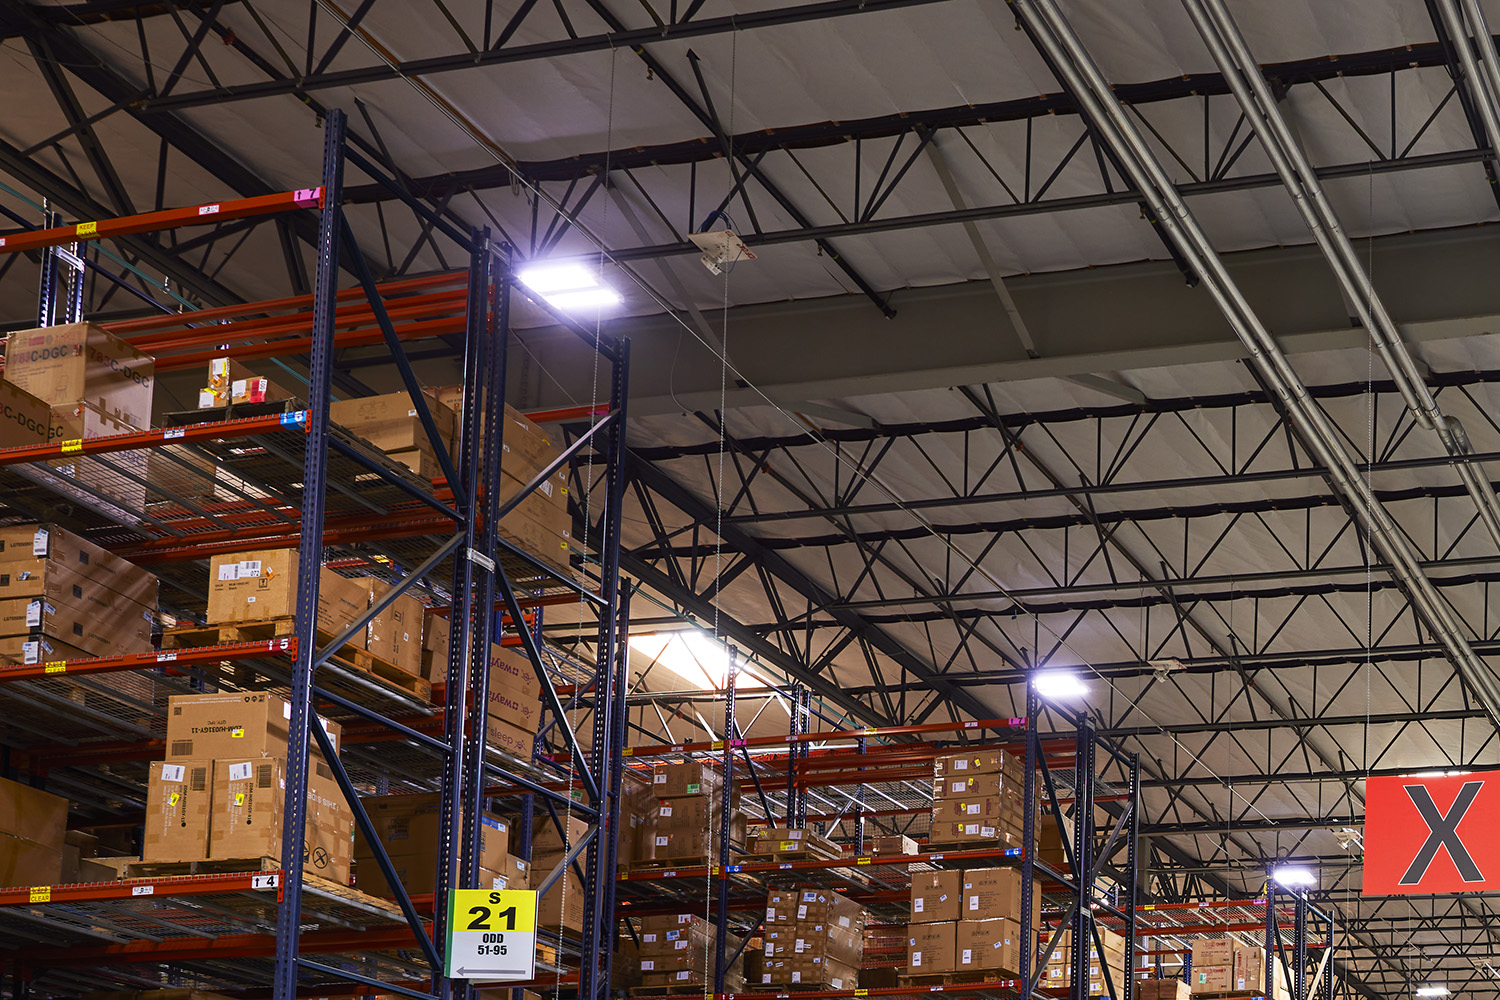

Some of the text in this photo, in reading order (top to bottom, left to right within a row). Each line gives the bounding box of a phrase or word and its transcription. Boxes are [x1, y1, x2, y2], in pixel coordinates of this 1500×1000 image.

[308, 188, 316, 198] 7
[295, 411, 302, 422] 6
[280, 639, 288, 649] 5
[265, 875, 276, 886] 4
[488, 892, 501, 904] S
[467, 906, 517, 930] 21
[482, 933, 504, 944] ODD
[477, 944, 508, 956] 51-95
